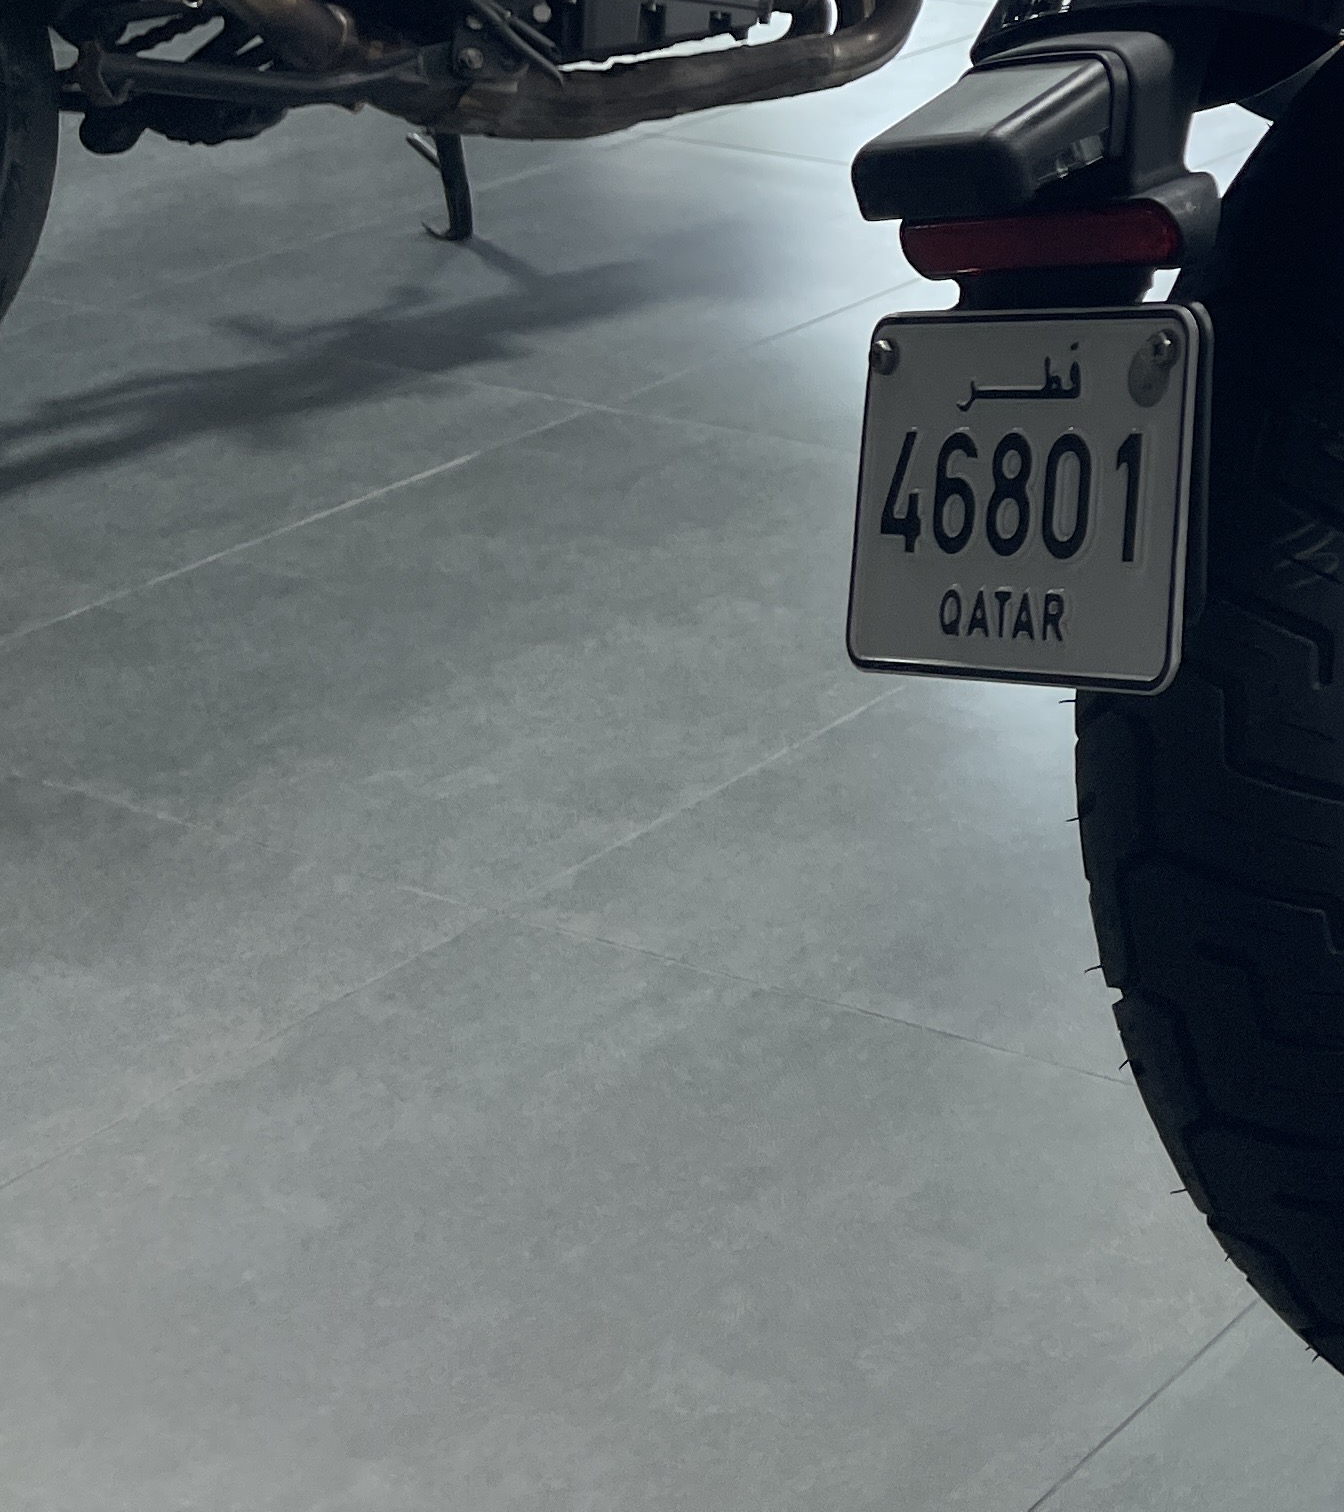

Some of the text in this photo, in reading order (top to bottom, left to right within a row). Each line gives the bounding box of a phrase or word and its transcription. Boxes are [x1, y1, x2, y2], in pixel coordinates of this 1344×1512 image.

[956, 341, 1083, 412] قطر
[880, 431, 1144, 564] 46801
[939, 588, 1066, 643] QATAR
